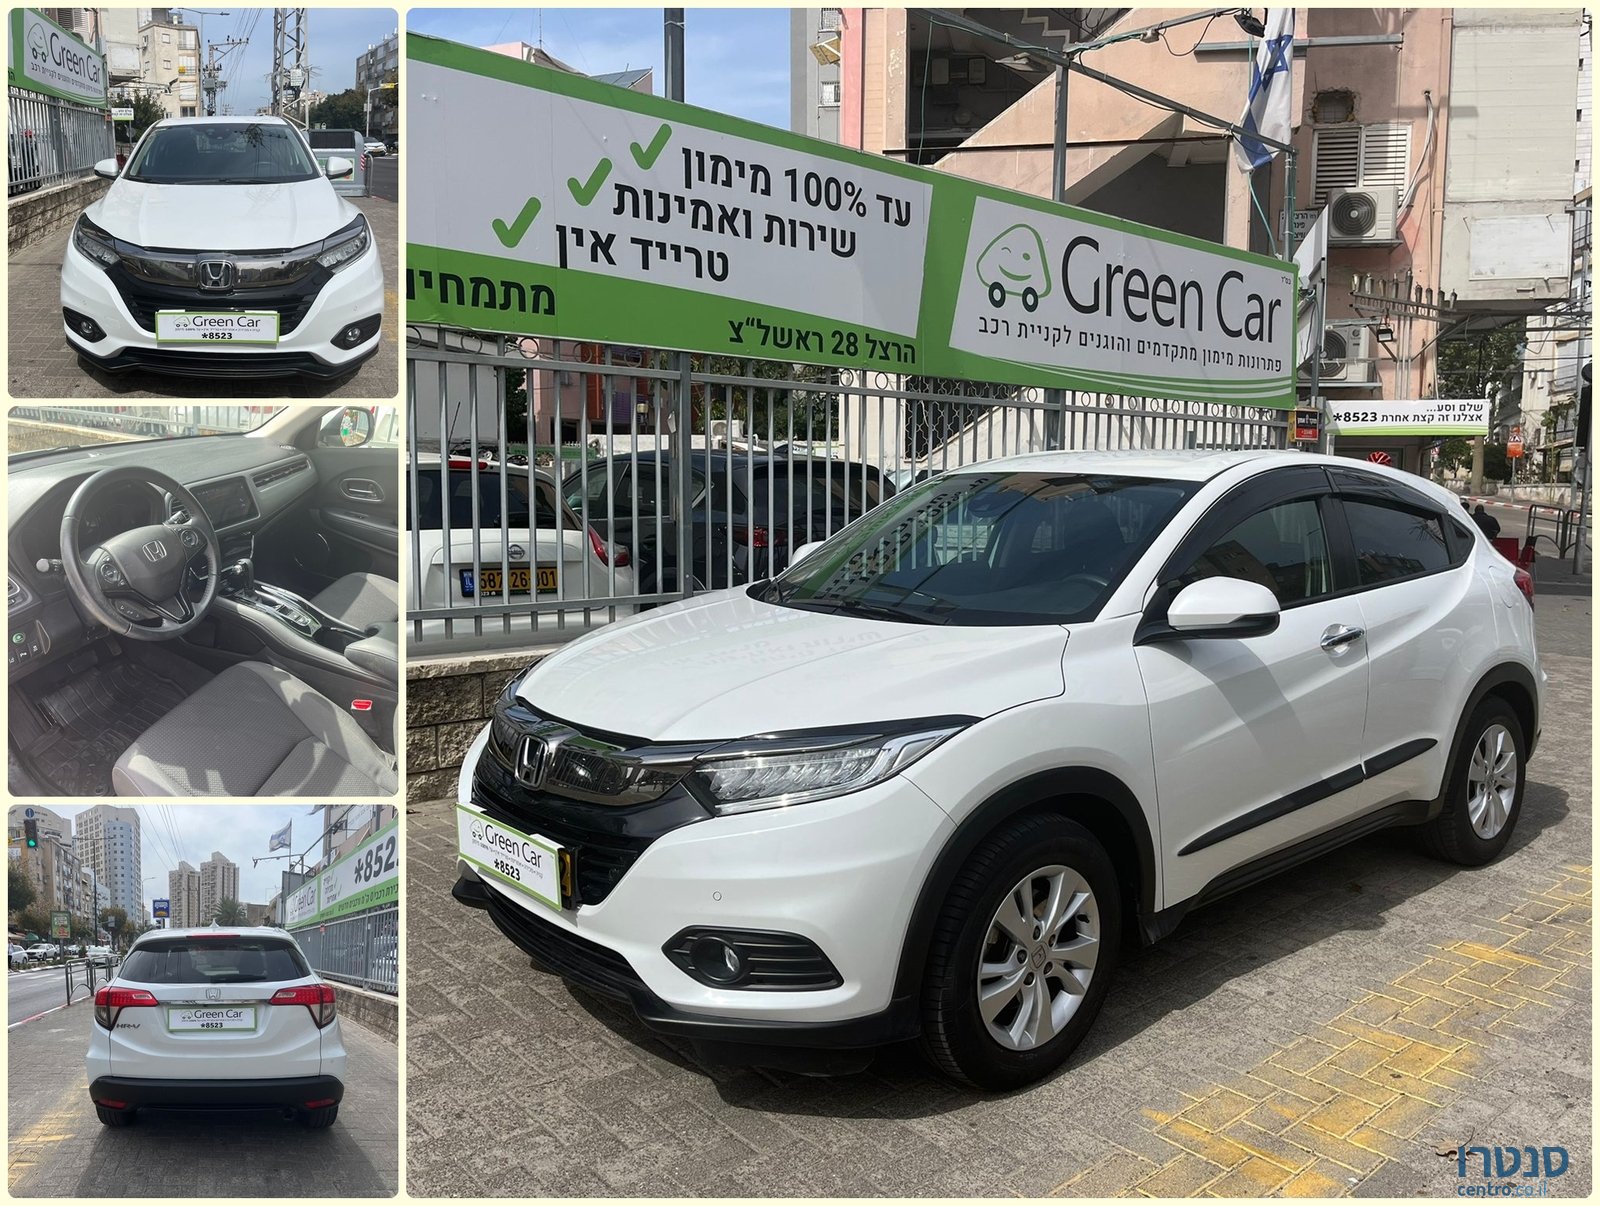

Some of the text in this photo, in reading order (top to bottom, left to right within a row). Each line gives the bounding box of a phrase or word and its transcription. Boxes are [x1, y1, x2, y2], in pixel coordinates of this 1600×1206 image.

[50, 32, 101, 84] Green Car
[682, 147, 911, 226] עד 100% מימון
[612, 183, 855, 258] שירות ואמינות
[556, 224, 729, 281] טרייד אין
[1061, 235, 1281, 343] Green Car
[192, 315, 261, 328] Green Car
[831, 330, 859, 357] 28
[865, 332, 916, 364] הרצל
[978, 316, 1281, 372] פתרונות מימון מתקדמים והוגנים לקניית רכב
[1381, 414, 1409, 422] אחרת
[1412, 414, 1435, 424] קצת
[1437, 414, 1449, 422] זה
[1453, 412, 1482, 422] אצלנו
[1459, 402, 1483, 412] שלם
[354, 835, 398, 884] 852
[485, 824, 542, 868] Green Car
[194, 1010, 243, 1019] Green Car
